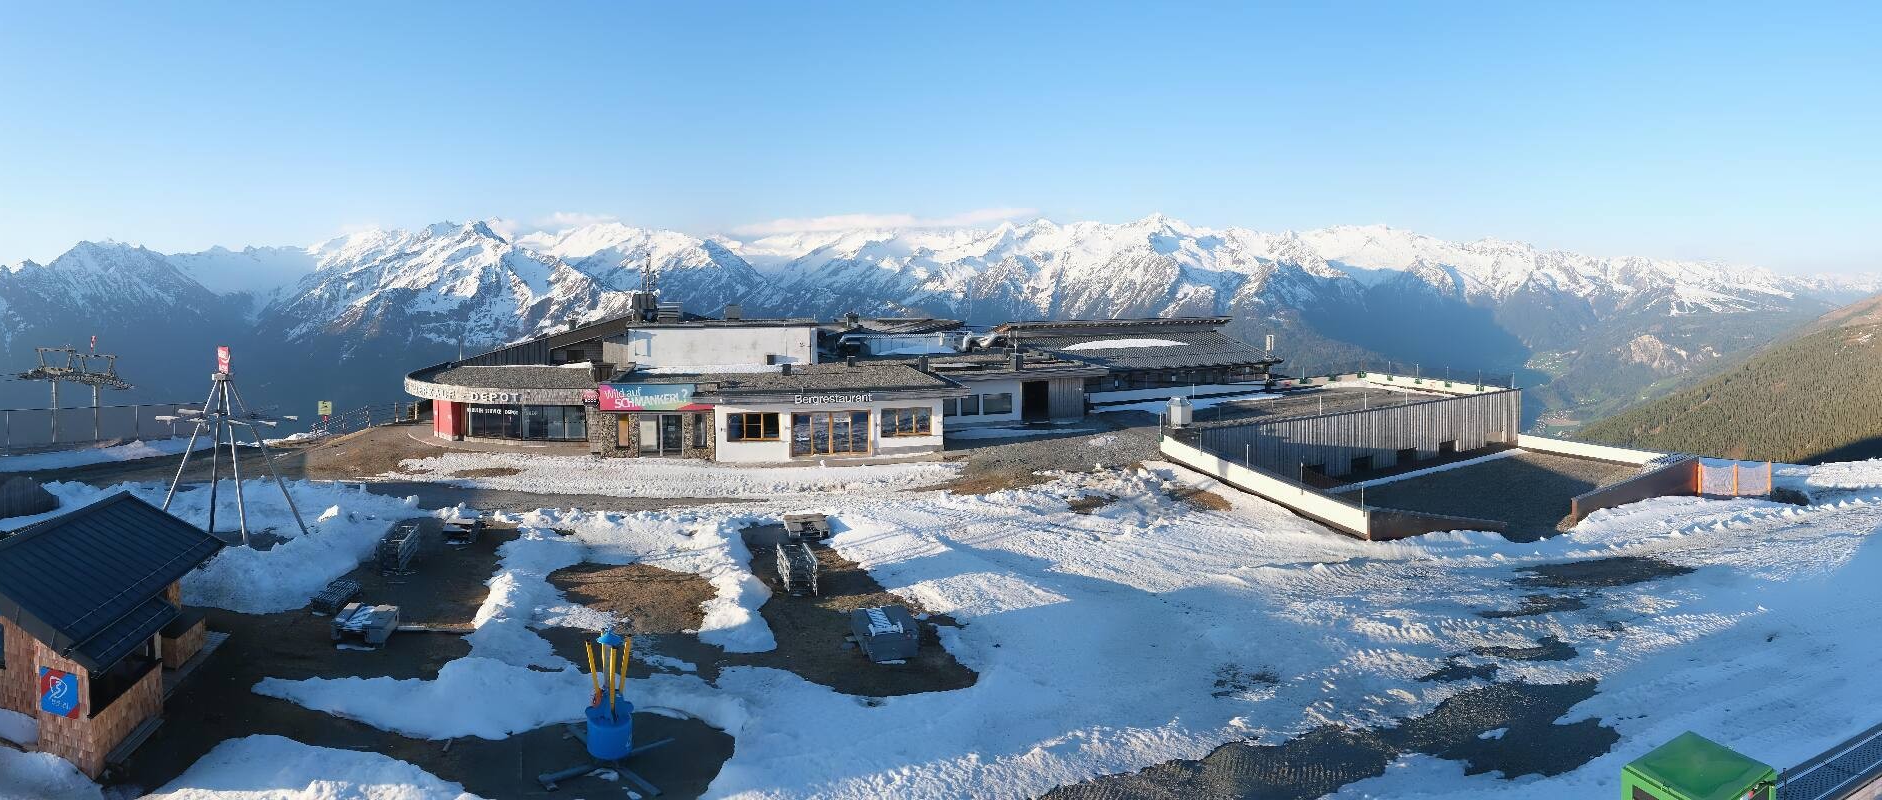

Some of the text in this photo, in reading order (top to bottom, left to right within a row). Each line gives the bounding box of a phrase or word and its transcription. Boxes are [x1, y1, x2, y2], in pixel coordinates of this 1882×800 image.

[470, 391, 519, 402] DEPOT
[604, 387, 641, 399] Wild auf
[614, 388, 688, 409] SCHMANKERL?
[795, 393, 872, 405] Bergrestaurant
